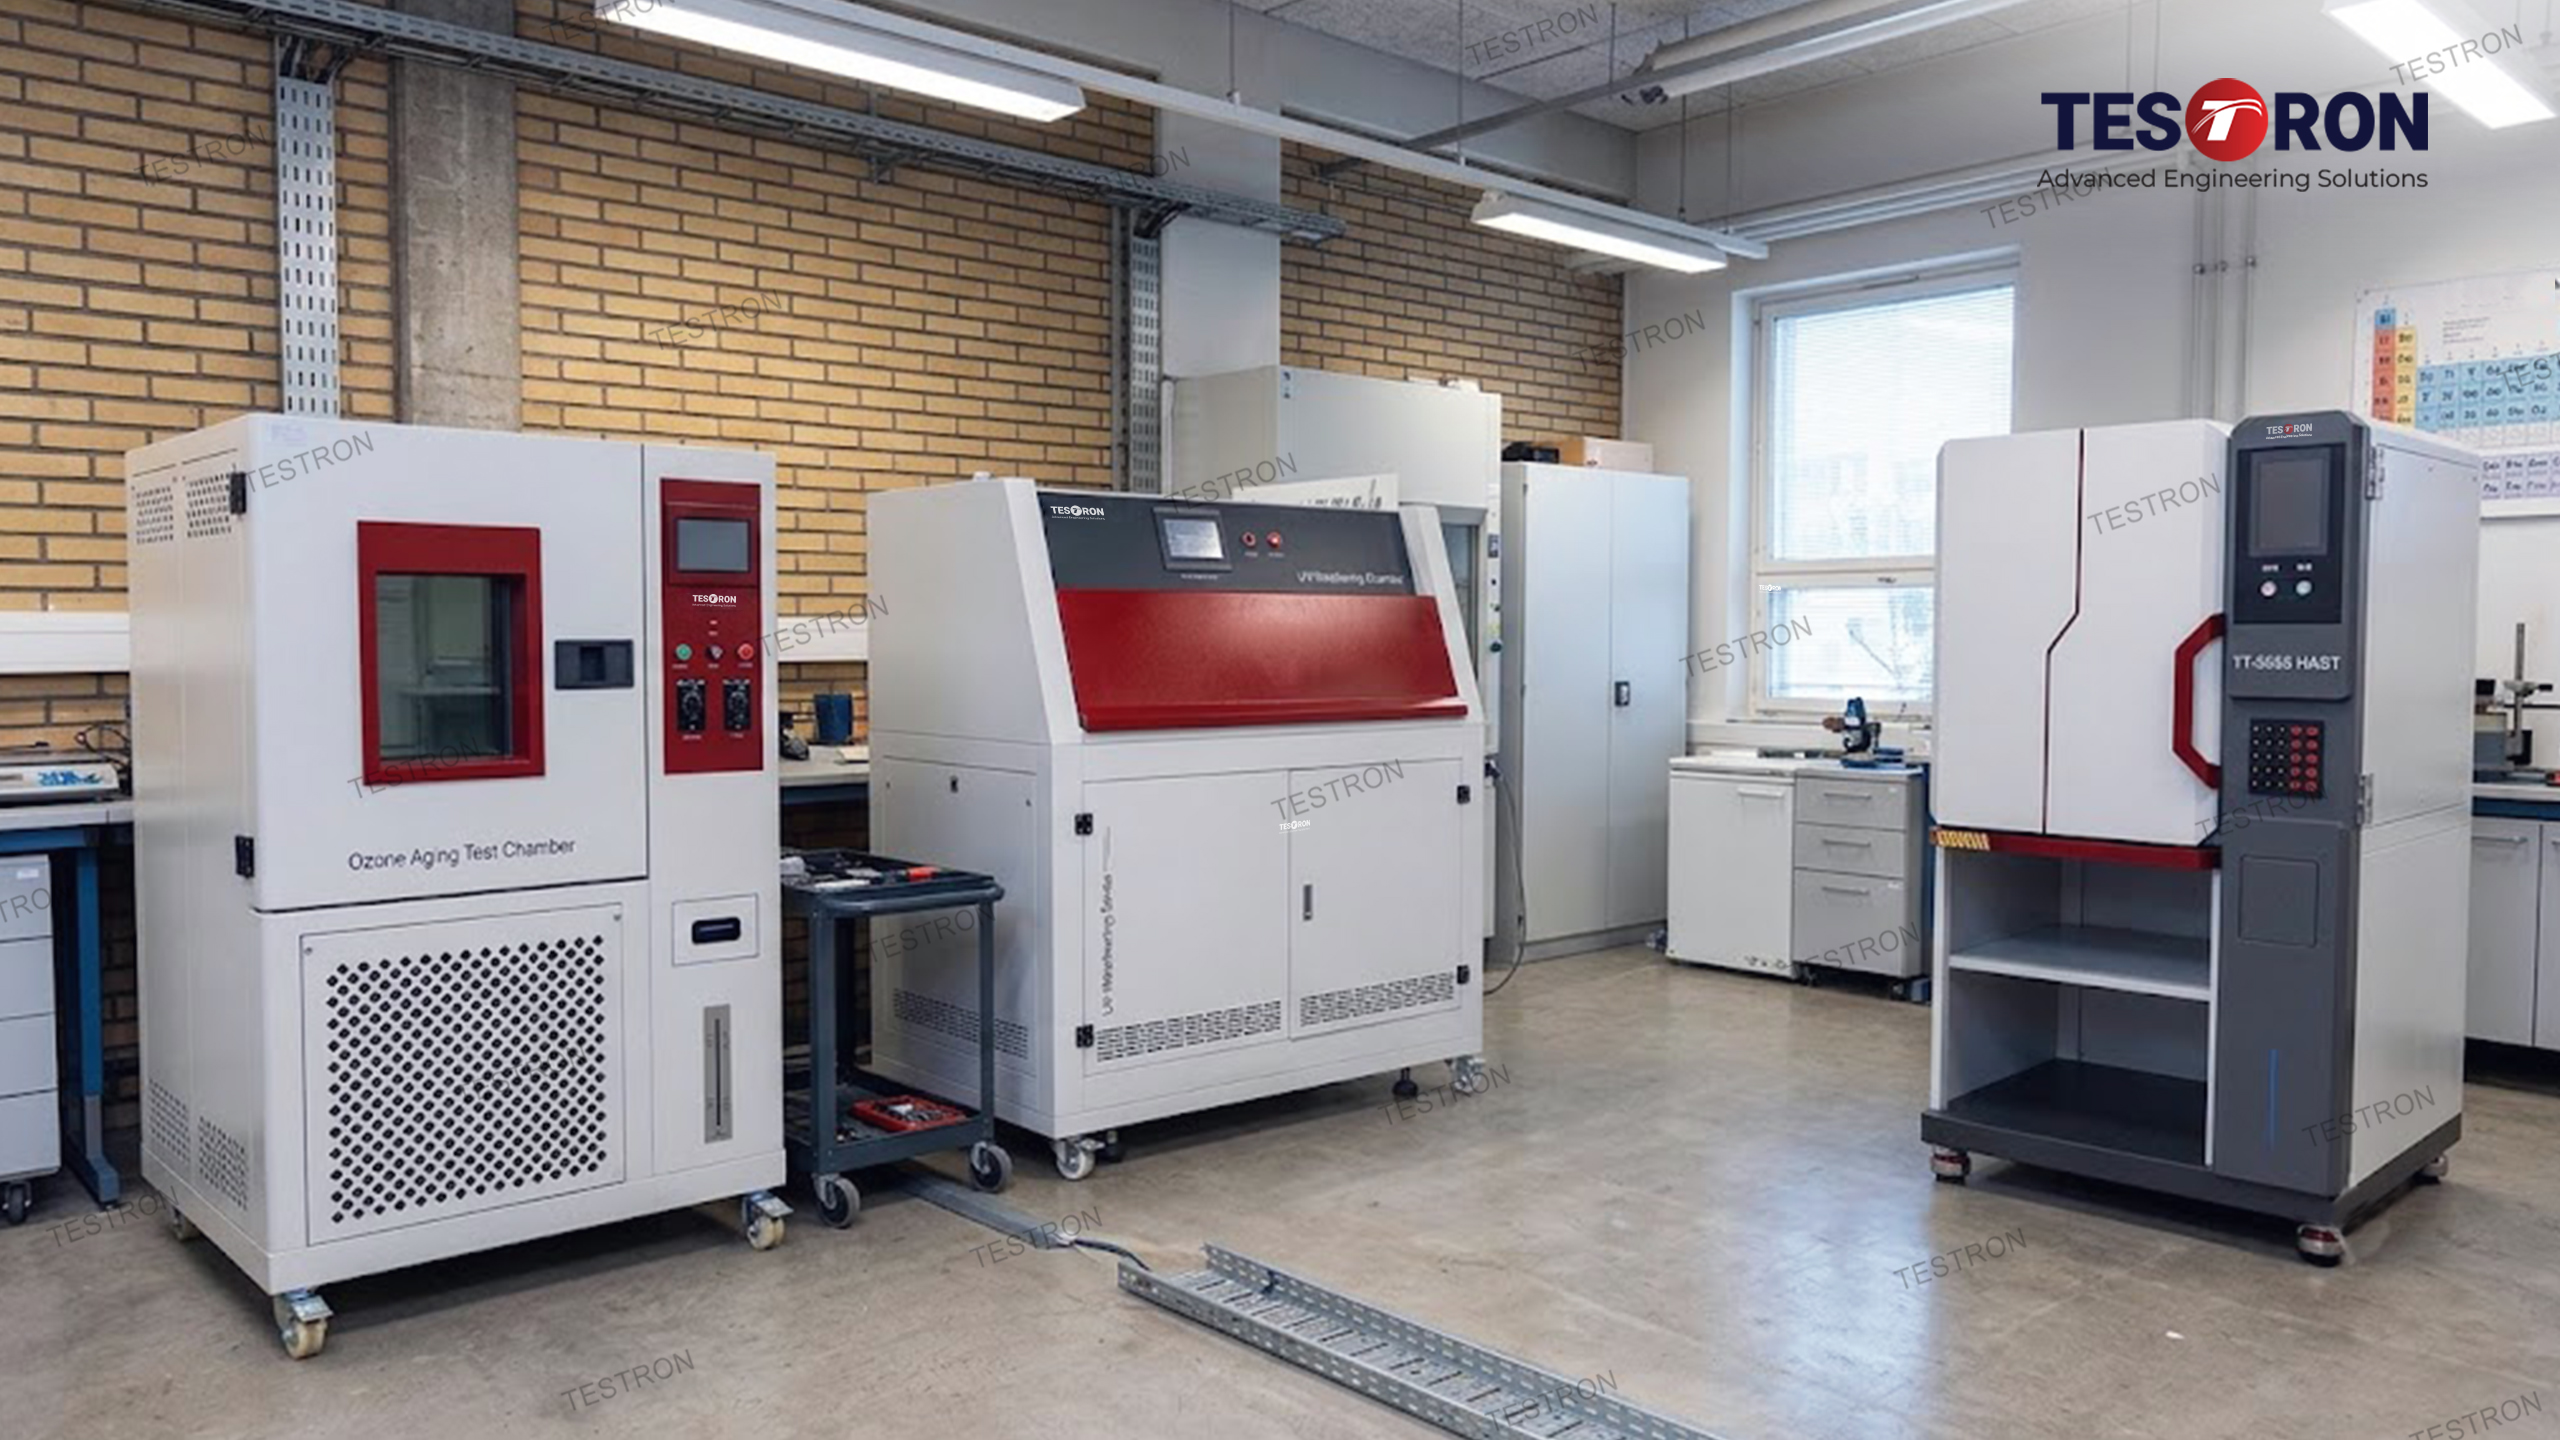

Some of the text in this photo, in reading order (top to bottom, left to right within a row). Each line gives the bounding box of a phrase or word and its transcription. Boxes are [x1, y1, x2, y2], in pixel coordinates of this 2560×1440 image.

[2265, 423, 2313, 435] TESTRON
[1050, 505, 1105, 516] TESTRON
[692, 594, 737, 603] TESTRON
[2296, 655, 2341, 671] HAST
[348, 838, 576, 870] Ozone Aging Test Chamber
